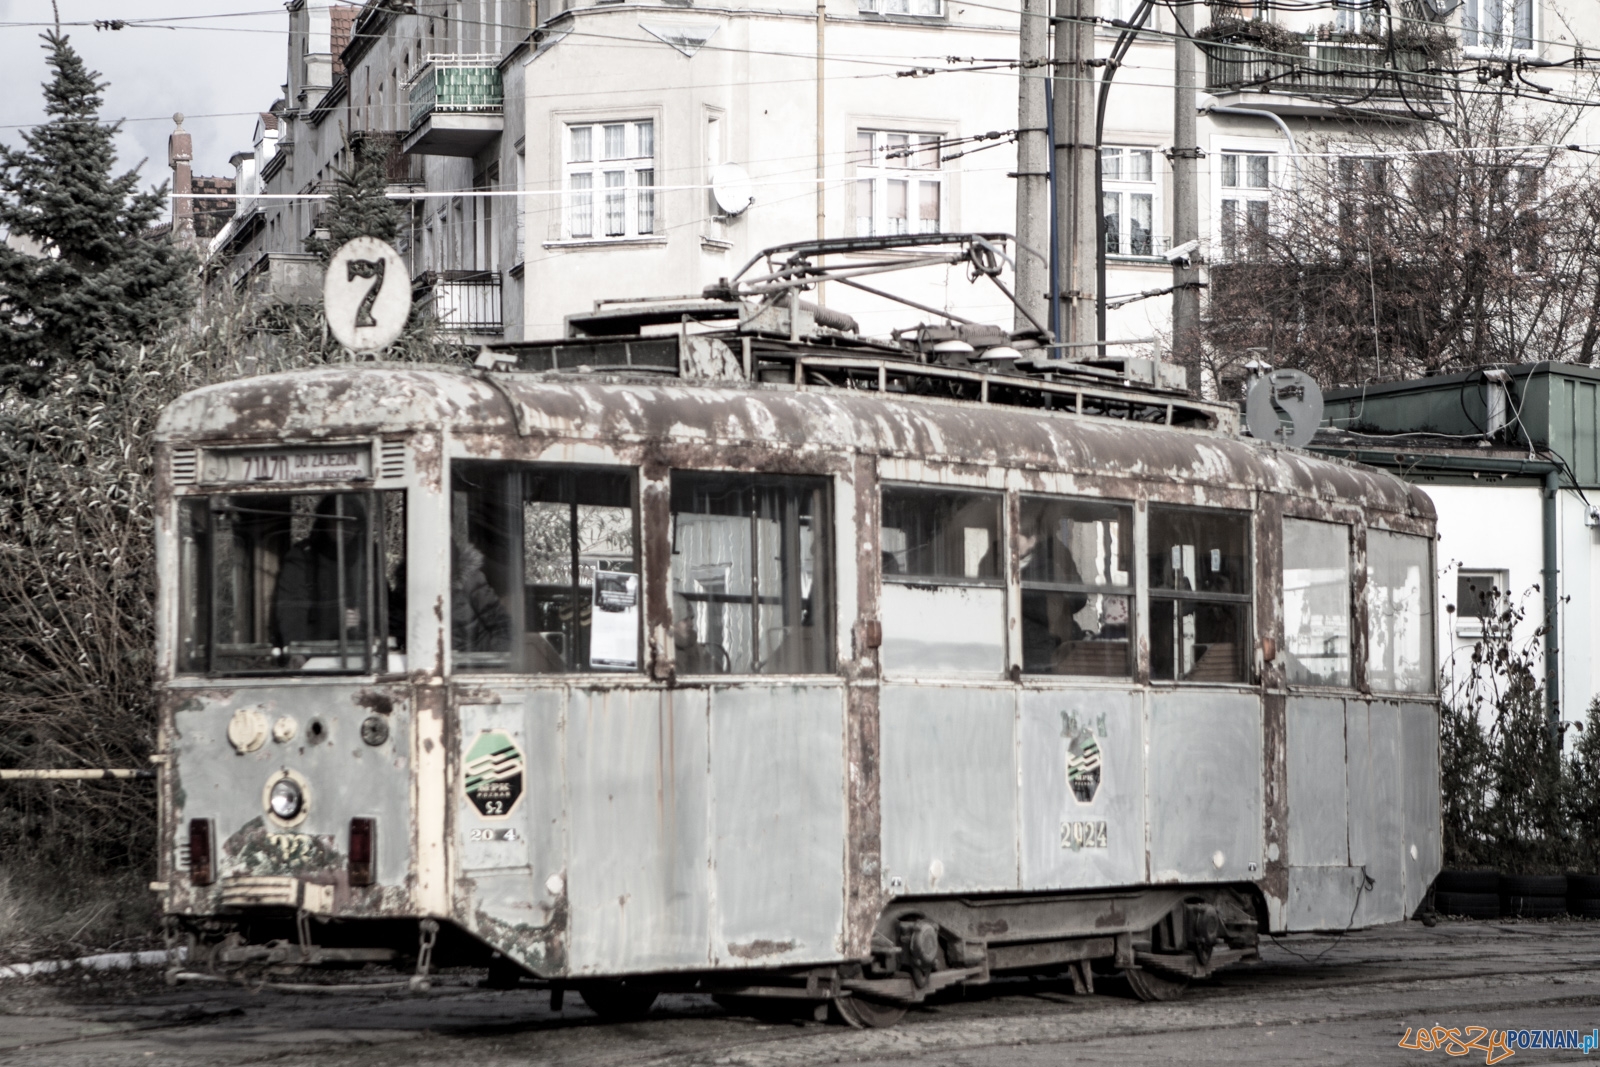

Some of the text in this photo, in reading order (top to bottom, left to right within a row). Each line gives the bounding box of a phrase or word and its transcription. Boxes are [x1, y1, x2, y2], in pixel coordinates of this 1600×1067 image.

[347, 257, 386, 328] 7
[485, 800, 503, 814] S-2
[470, 828, 516, 841] 204
[1060, 821, 1107, 848] 2024
